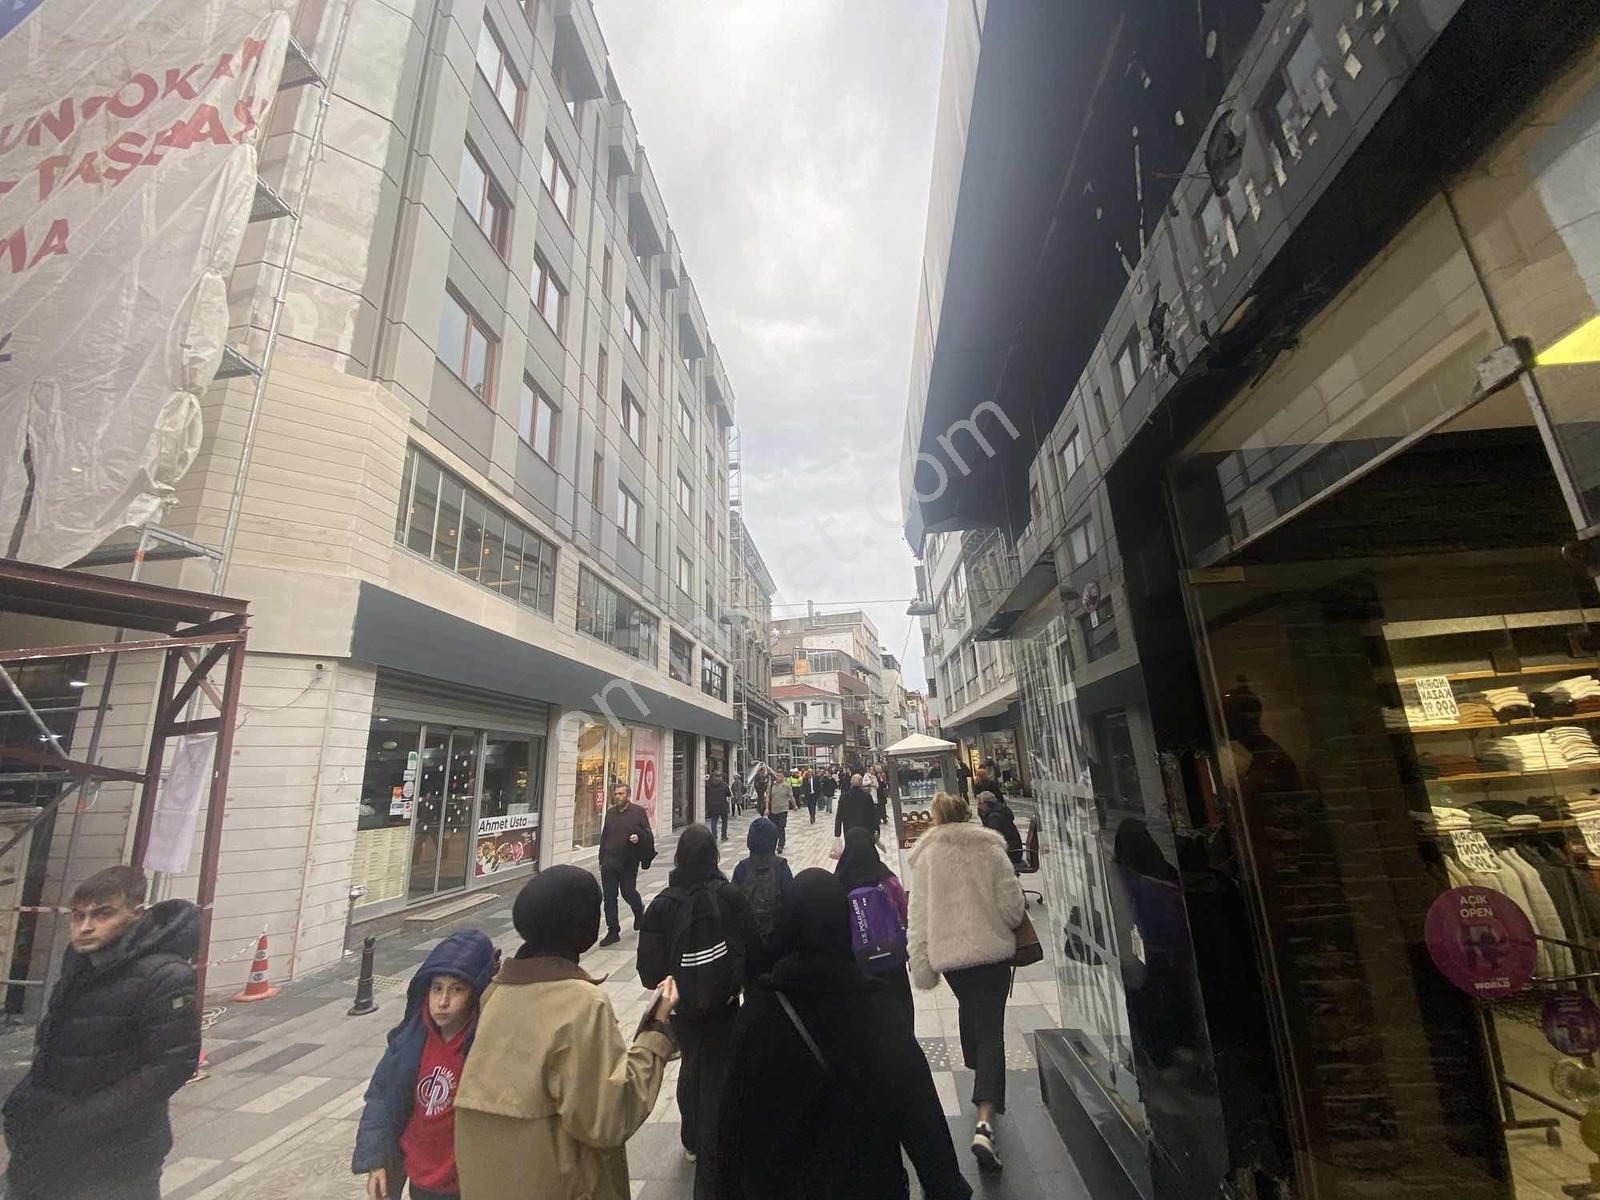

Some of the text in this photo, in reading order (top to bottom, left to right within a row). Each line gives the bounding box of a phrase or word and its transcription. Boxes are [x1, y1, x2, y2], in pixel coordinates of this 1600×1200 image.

[478, 816, 527, 831] Ahmet Usta
[1460, 896, 1487, 907] AÇIK
[1460, 908, 1493, 918] OPEN
